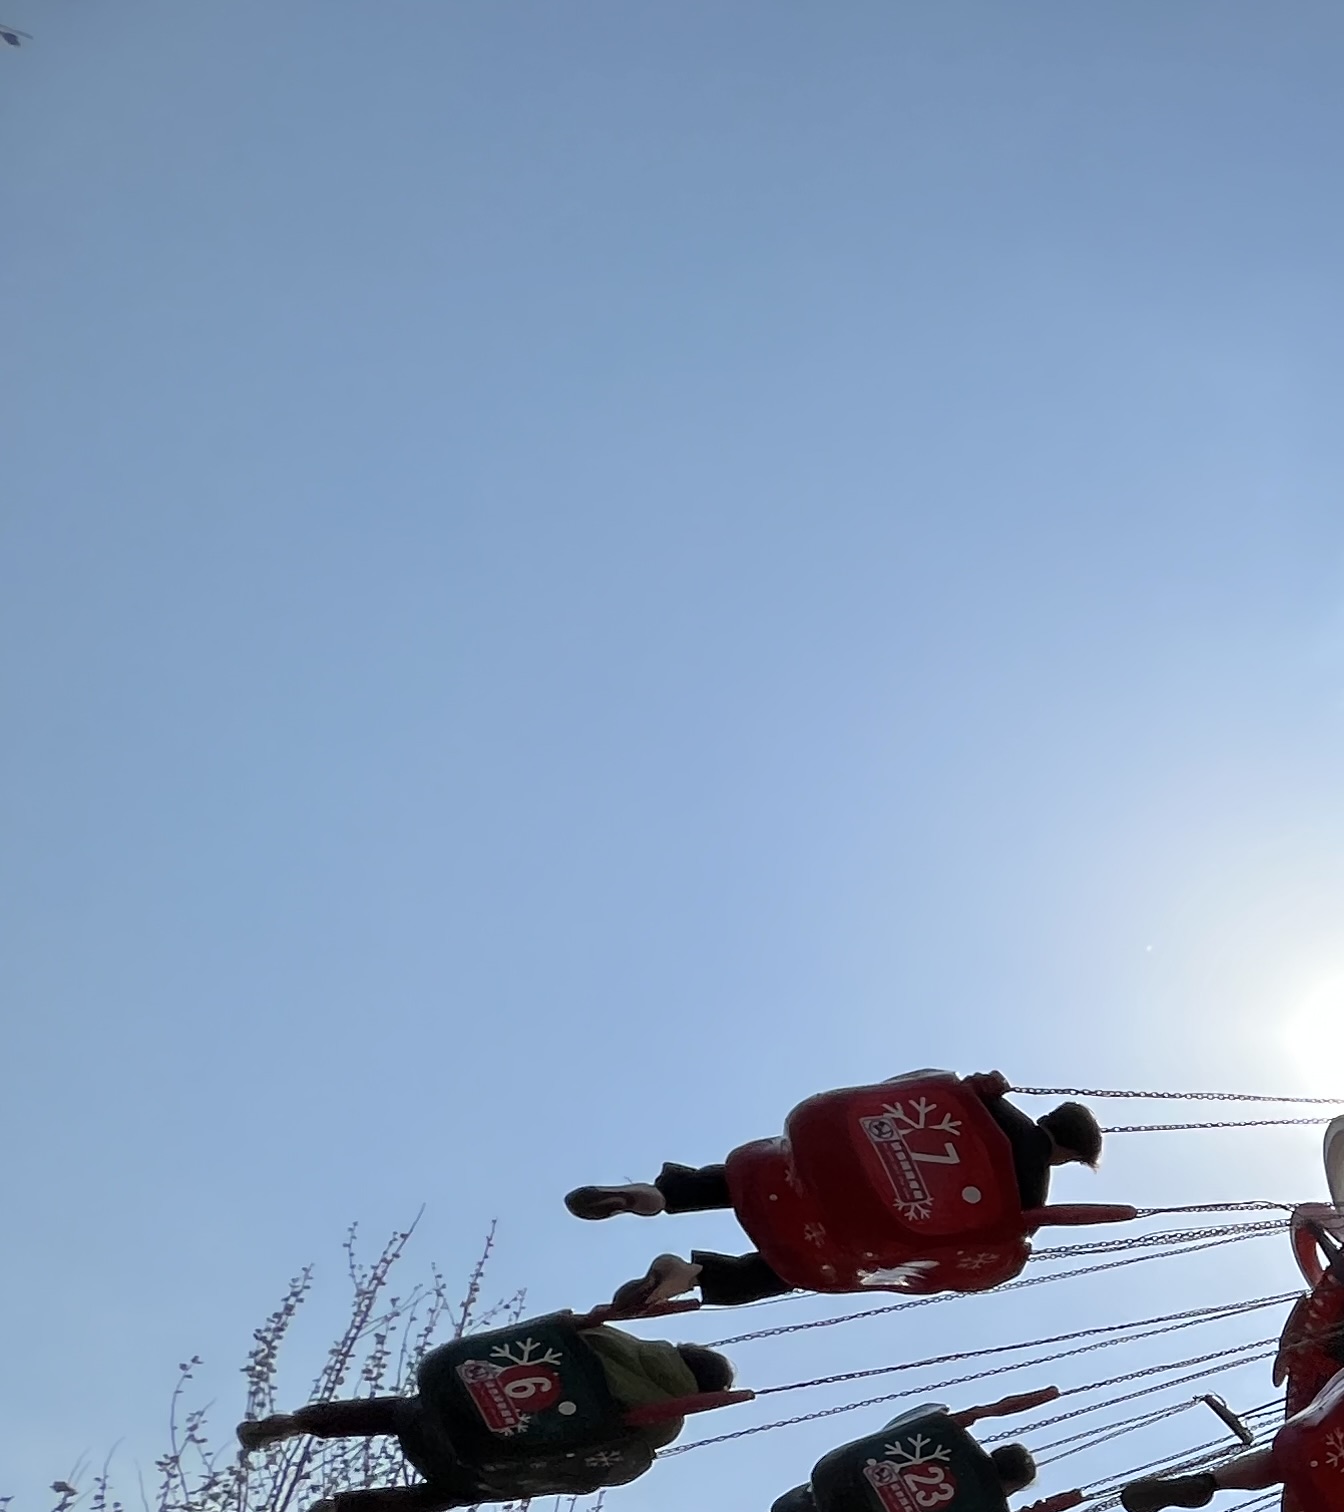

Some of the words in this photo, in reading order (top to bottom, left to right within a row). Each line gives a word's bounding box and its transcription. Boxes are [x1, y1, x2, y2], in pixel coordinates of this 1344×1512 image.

[910, 1141, 960, 1165] 7
[504, 1376, 552, 1399] 6
[903, 1466, 955, 1508] 23
